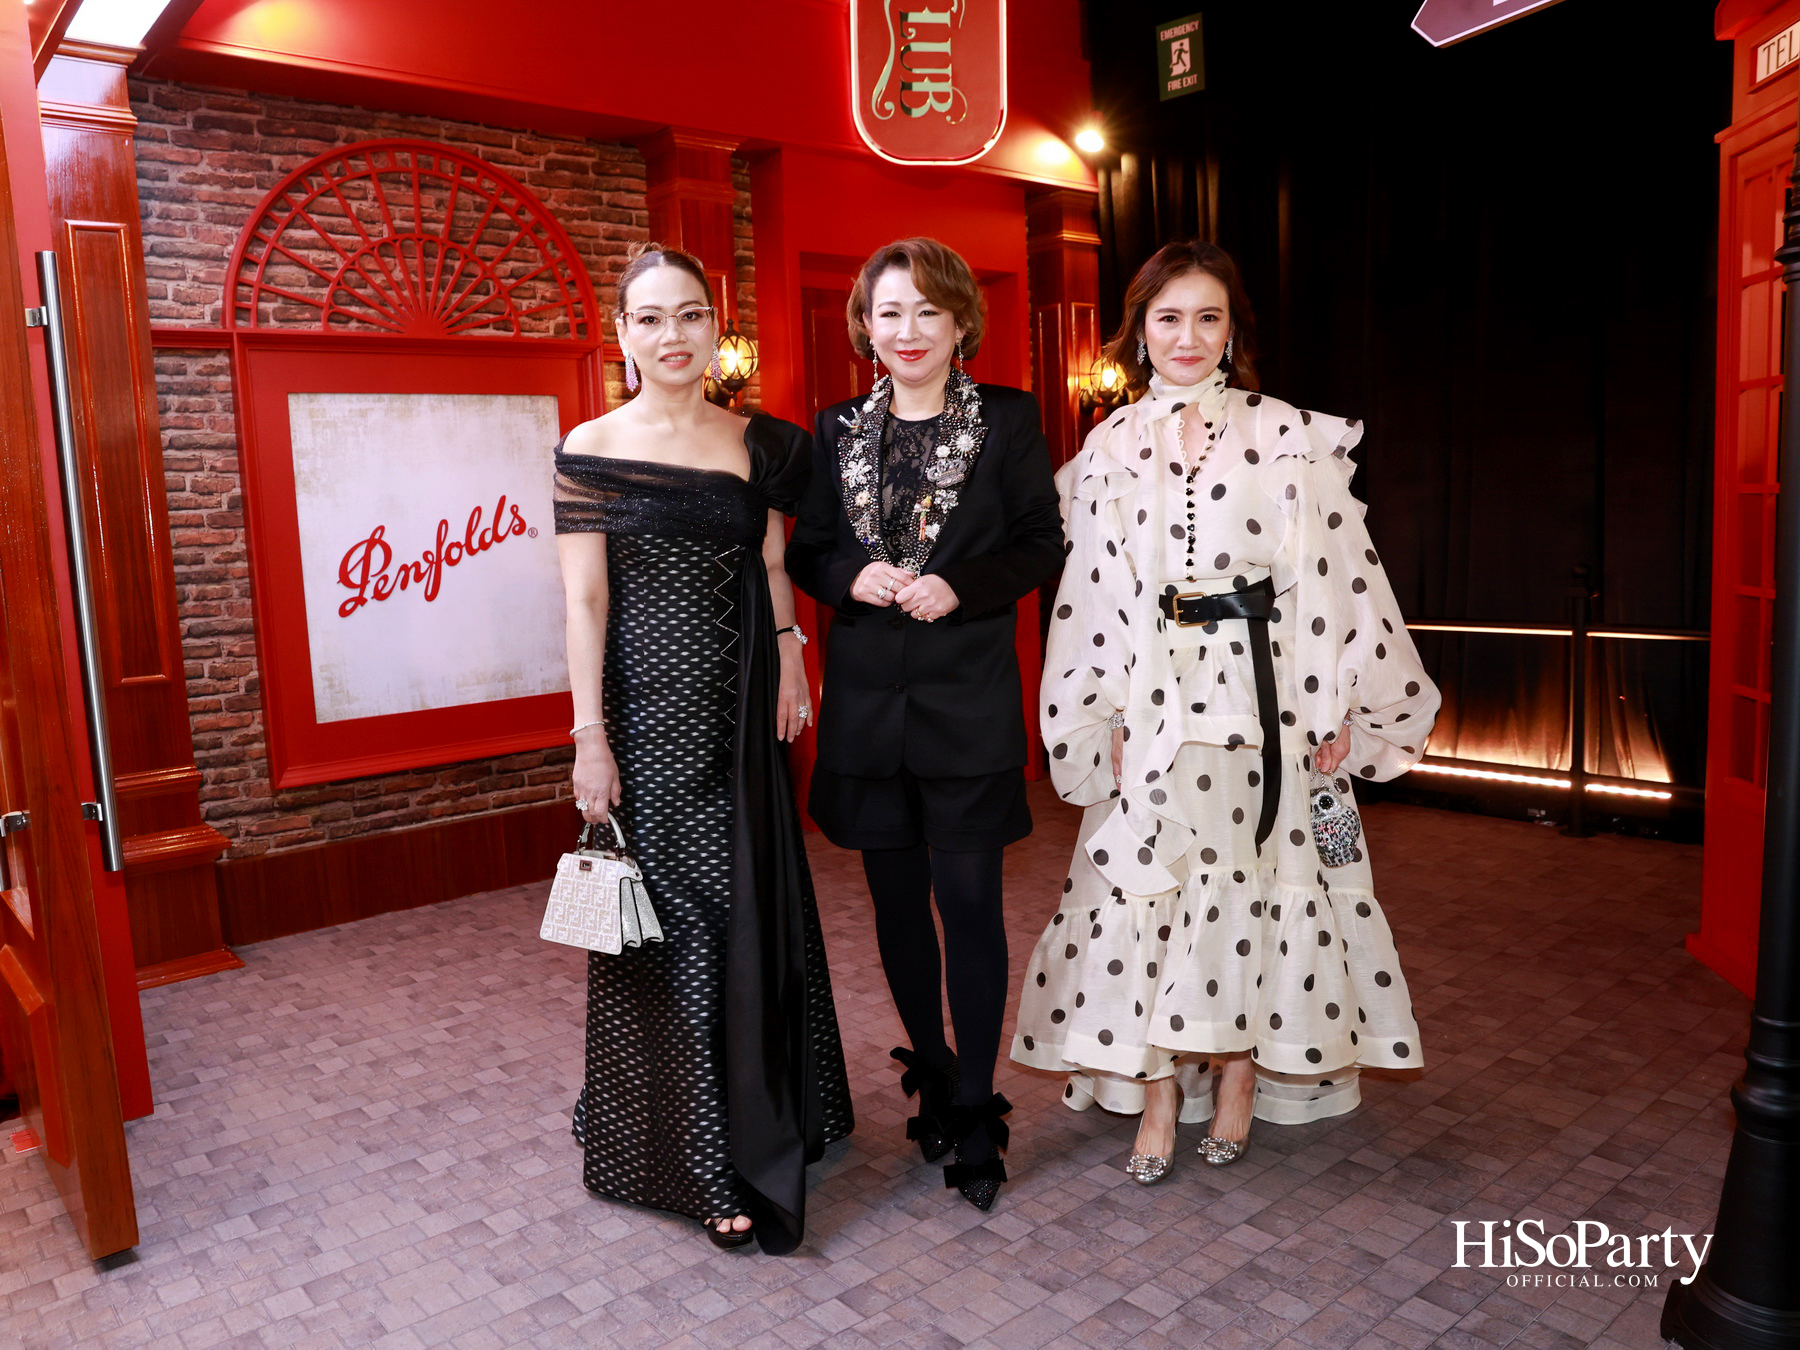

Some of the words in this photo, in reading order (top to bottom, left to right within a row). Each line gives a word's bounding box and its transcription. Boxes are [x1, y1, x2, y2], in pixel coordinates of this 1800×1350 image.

[1160, 20, 1200, 42] EMERGENCY
[900, 0, 967, 124] LUB
[1167, 78, 1182, 92] FIRE
[1182, 74, 1198, 88] EXIT
